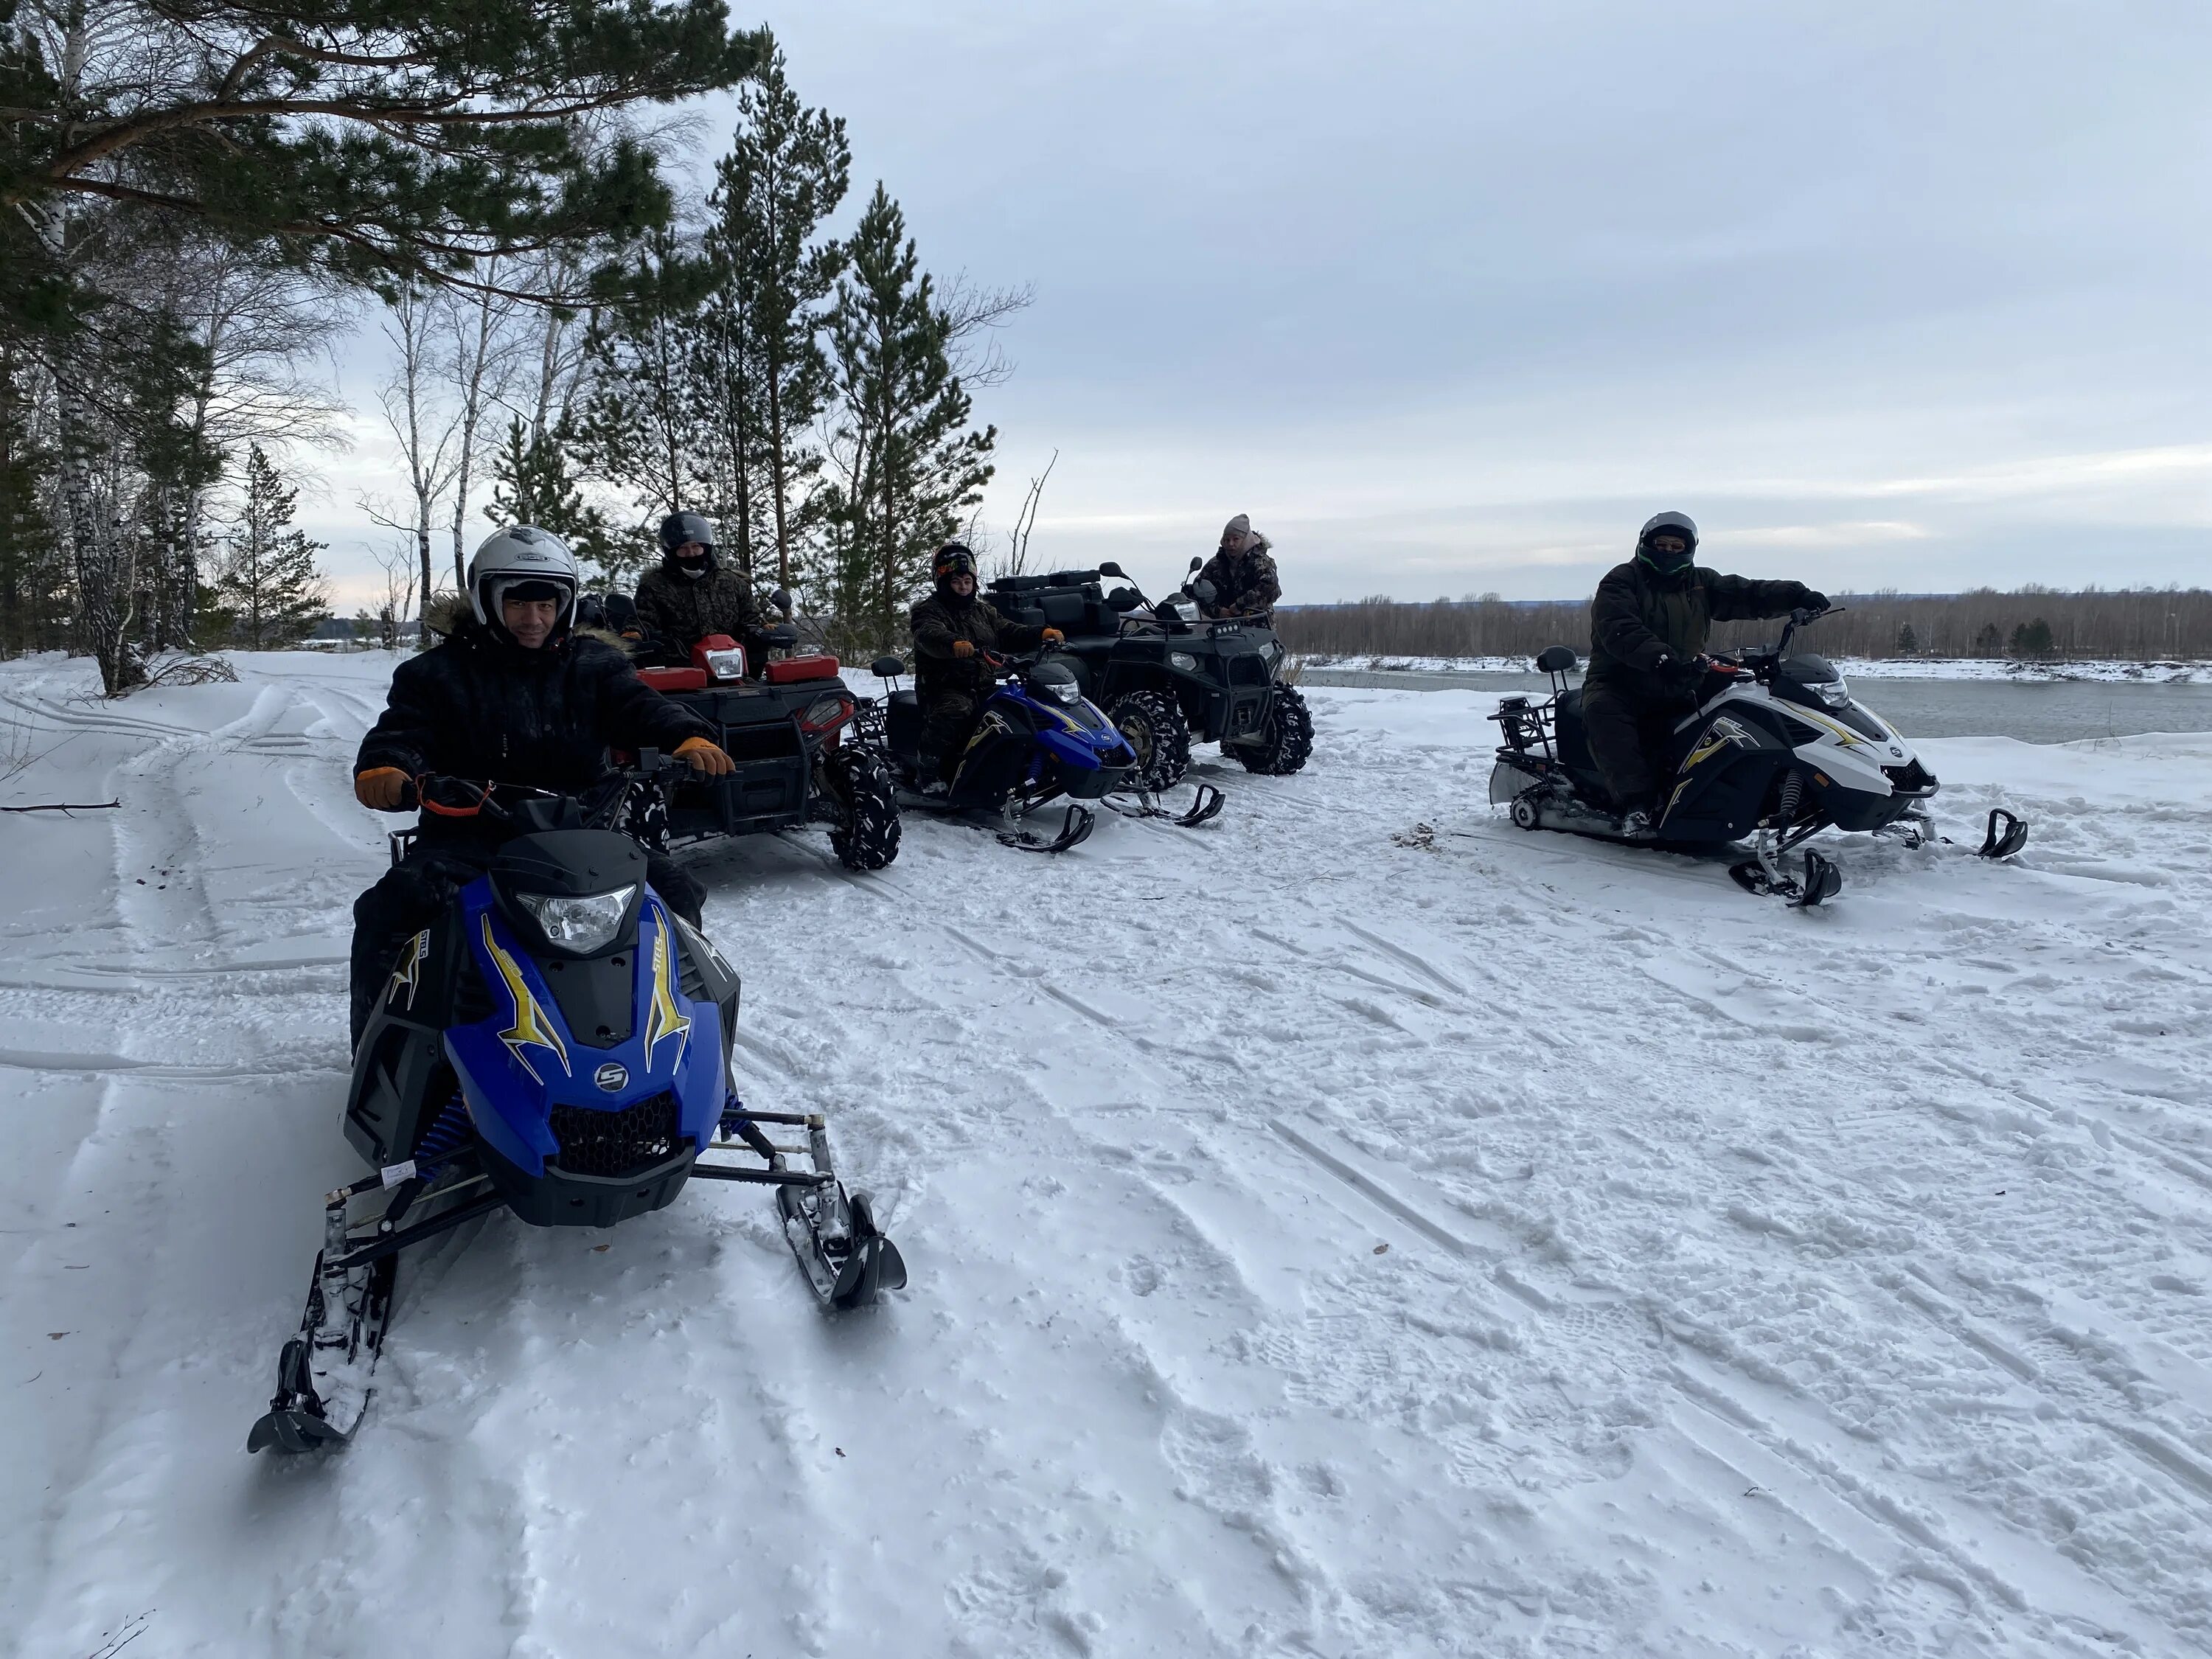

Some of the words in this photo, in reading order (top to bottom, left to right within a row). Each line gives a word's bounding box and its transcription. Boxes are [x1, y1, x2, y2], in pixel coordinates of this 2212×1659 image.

[419, 930, 429, 959] STELS
[653, 936, 663, 973] STELS
[498, 949, 524, 978] S150
